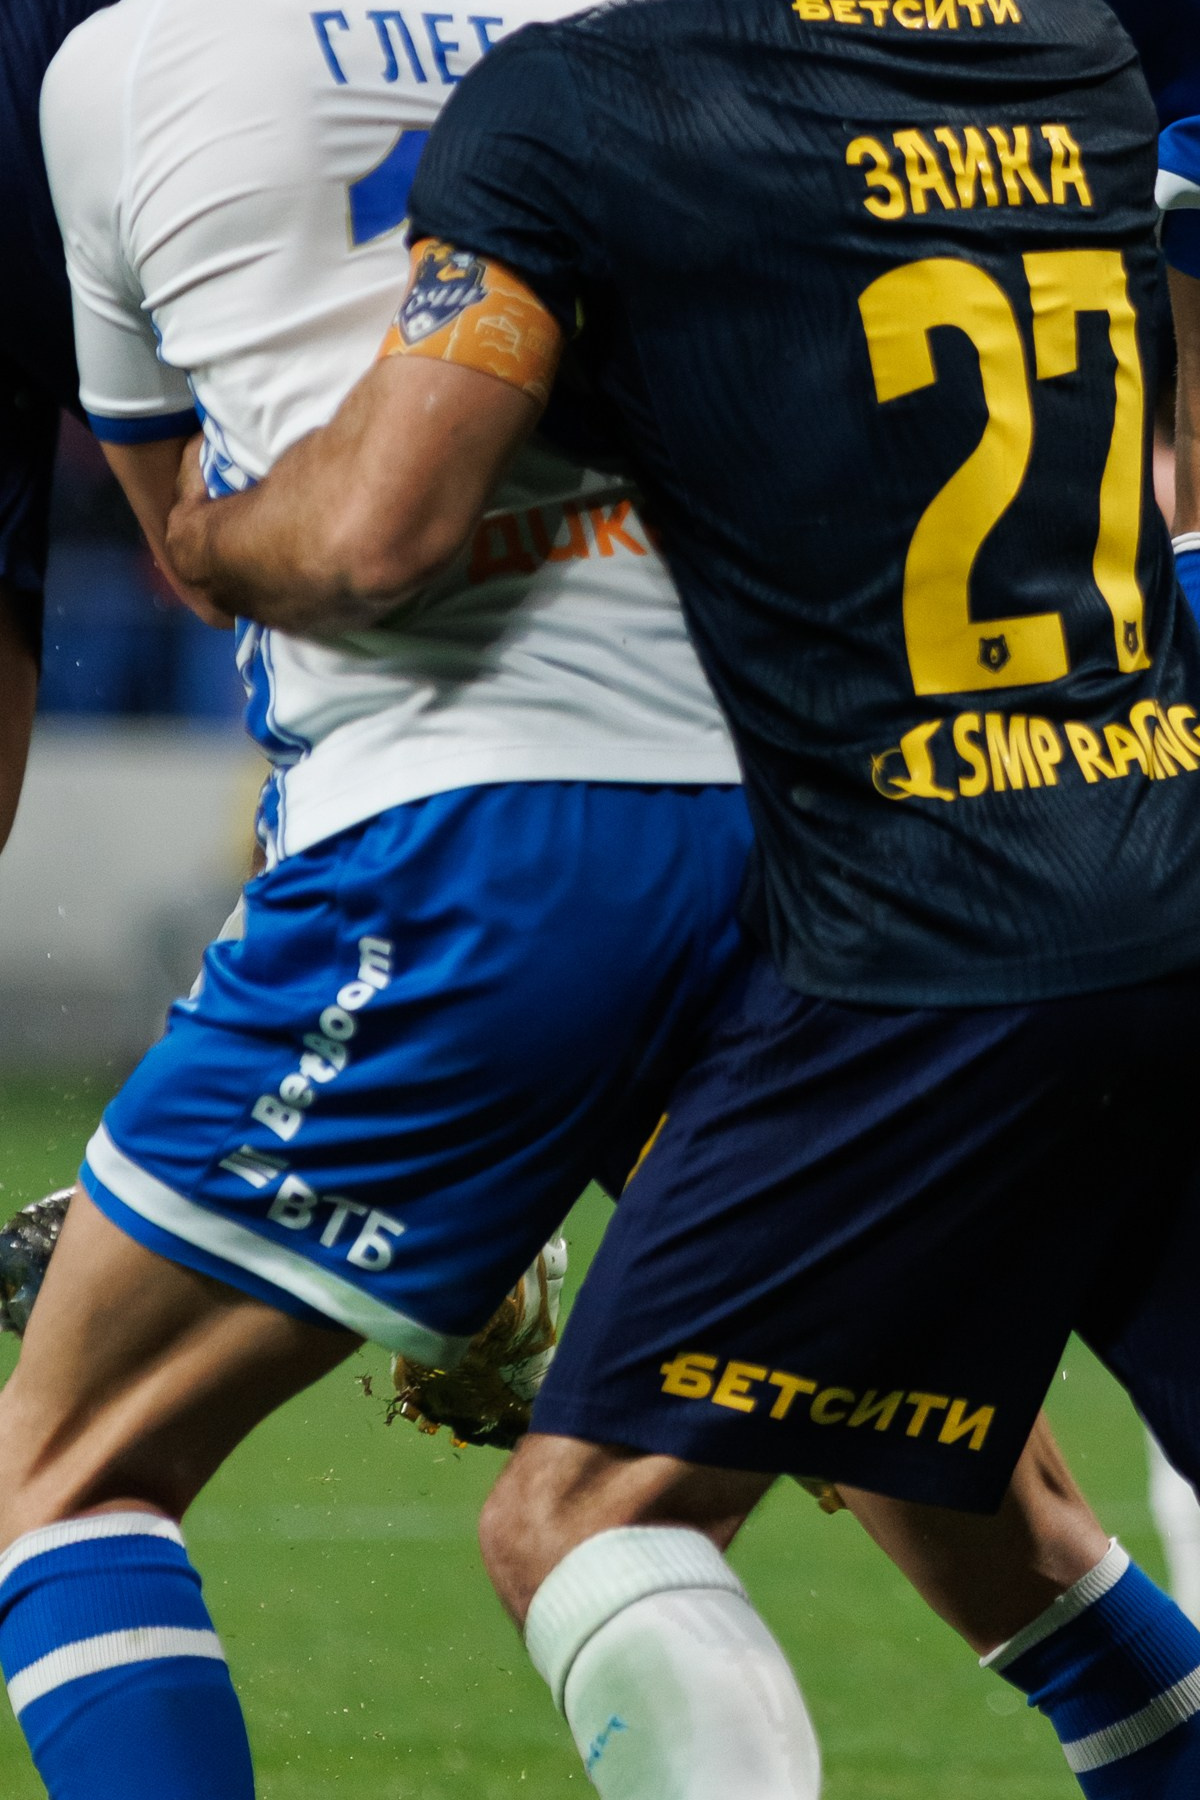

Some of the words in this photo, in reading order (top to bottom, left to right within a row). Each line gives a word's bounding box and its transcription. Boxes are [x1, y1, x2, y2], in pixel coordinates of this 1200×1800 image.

[845, 123, 1093, 220] ЗАИКА
[857, 248, 1151, 696] 27
[953, 711, 1063, 798] SMP
[267, 1174, 405, 1272] ВТБ
[659, 1351, 996, 1451] БЕТСИТИ
